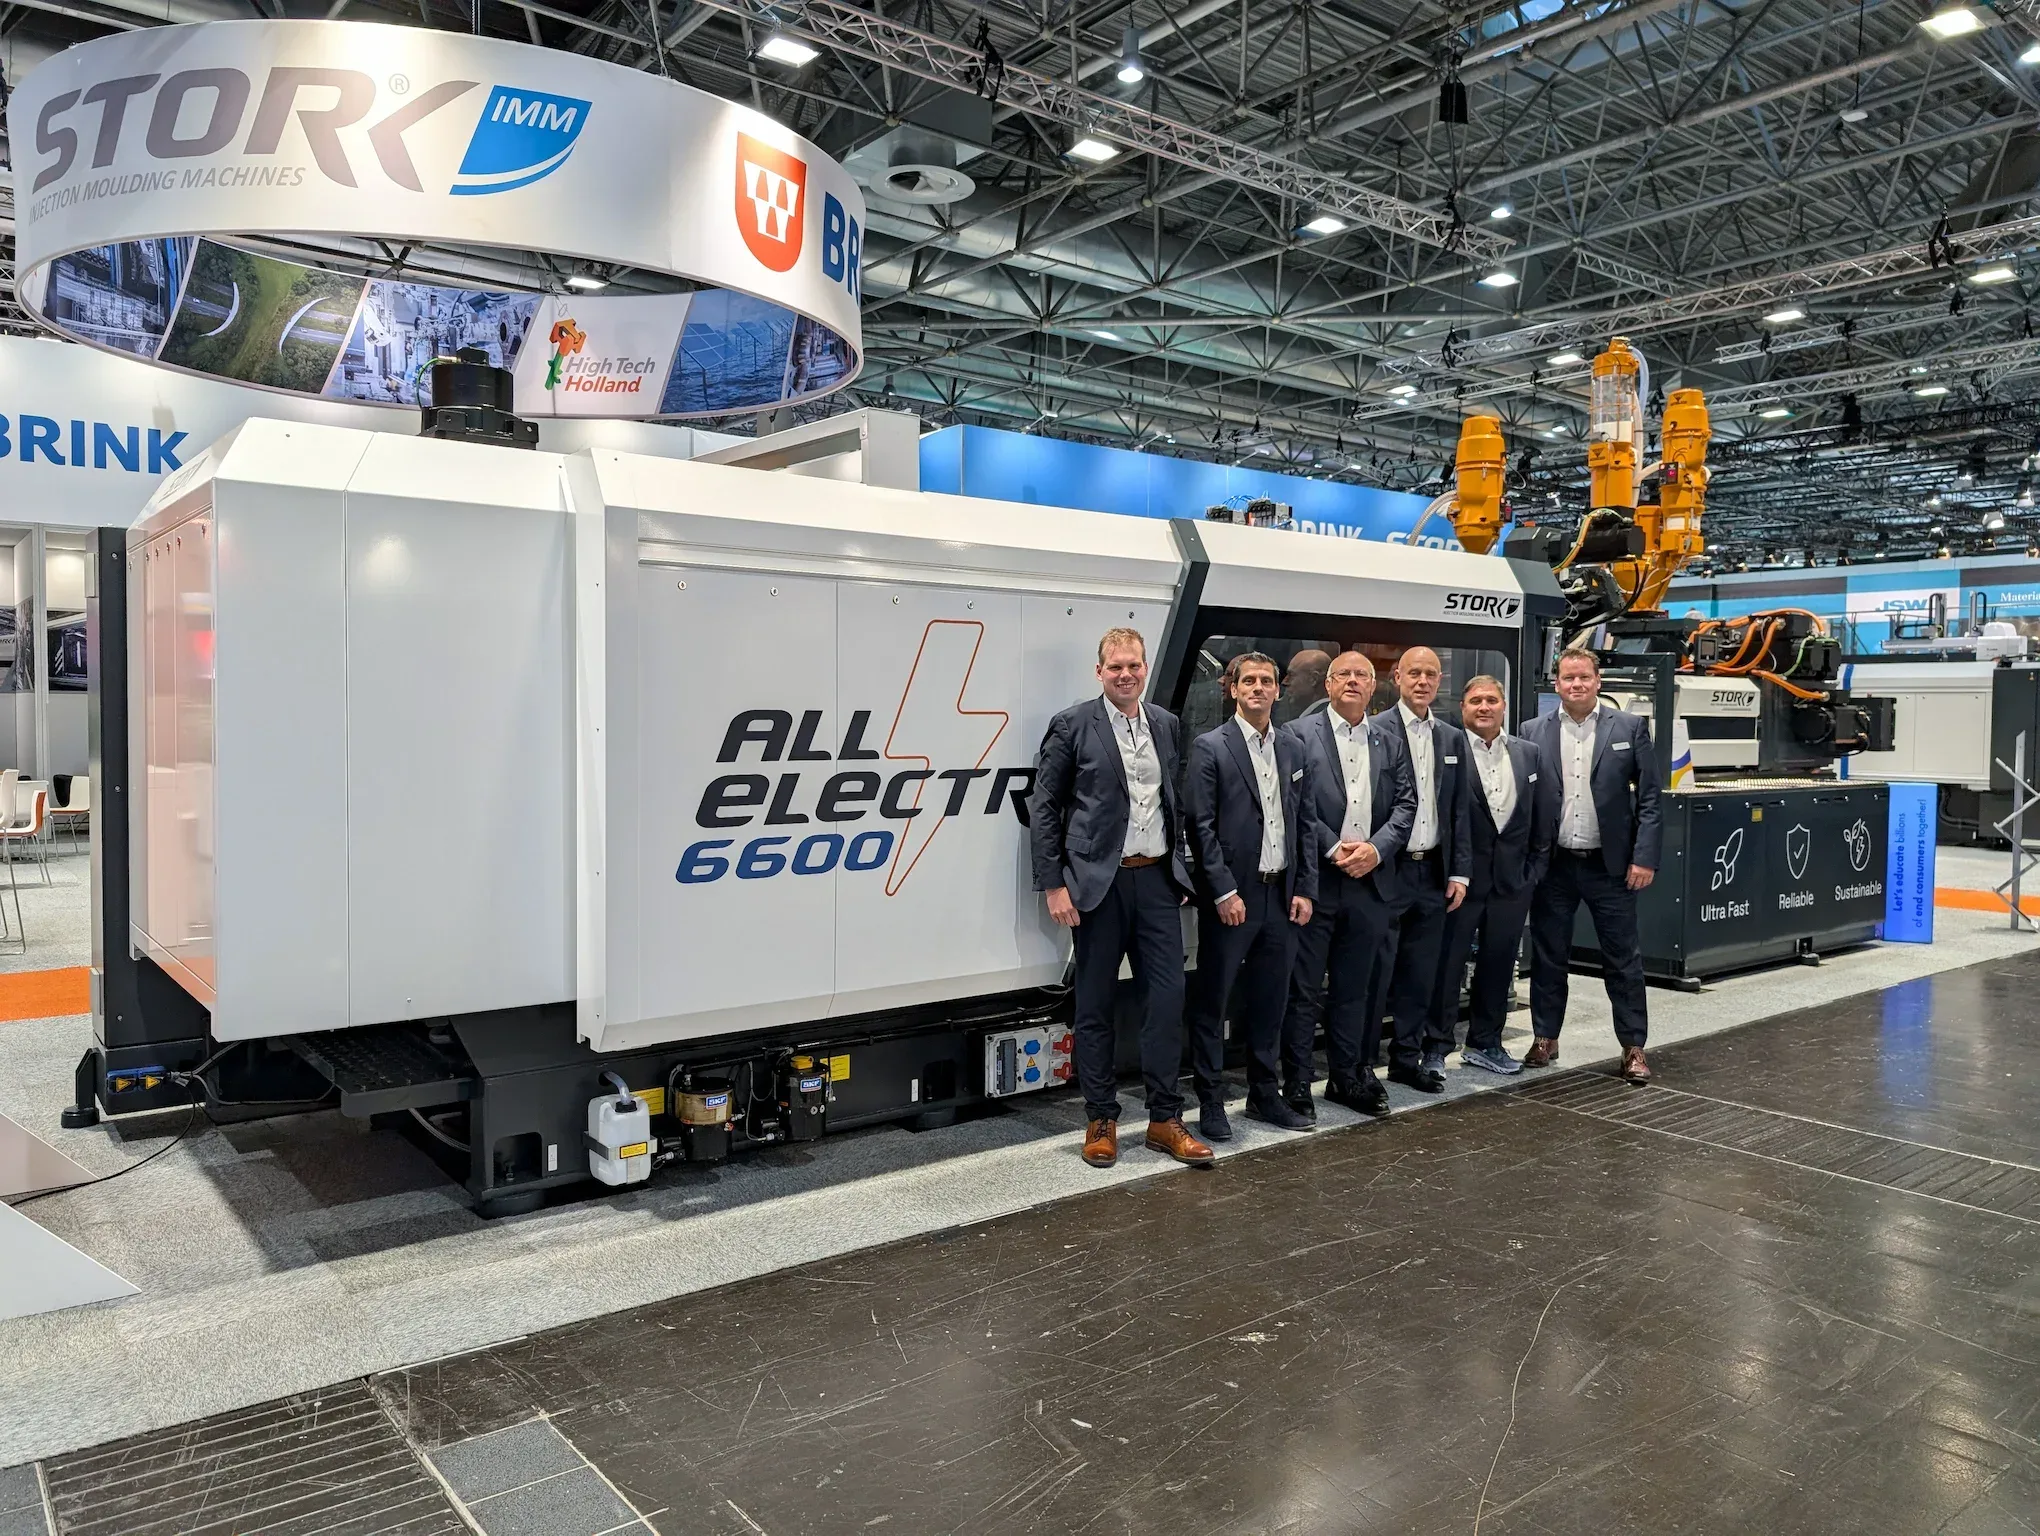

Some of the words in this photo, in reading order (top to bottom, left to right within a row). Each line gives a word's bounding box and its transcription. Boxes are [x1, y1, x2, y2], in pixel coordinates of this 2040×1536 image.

[491, 95, 578, 133] IMM
[32, 67, 481, 195] STORK
[28, 187, 81, 226] INJECTION
[82, 170, 177, 202] MOULDING
[180, 166, 306, 188] MACHINES
[822, 191, 860, 307] BR
[565, 356, 613, 378] High
[616, 356, 656, 375] Tech
[564, 375, 643, 393] Holland
[1444, 592, 1508, 618] STORK
[1875, 599, 1928, 611] JSW
[1711, 690, 1748, 706] STORK
[715, 709, 880, 763] ALL
[1895, 812, 1906, 844] billions
[675, 830, 895, 884] 6600
[1893, 845, 1905, 886] educate
[1916, 840, 1926, 895] consumers
[1778, 889, 1815, 910] Reliable
[1834, 880, 1882, 901] Sustainable
[1893, 889, 1904, 912] Let's
[1700, 903, 1727, 922] Ultra
[1728, 900, 1750, 918] Fast
[1912, 897, 1924, 917] end
[802, 1079, 820, 1088] SKF
[708, 1096, 727, 1106] SKF
